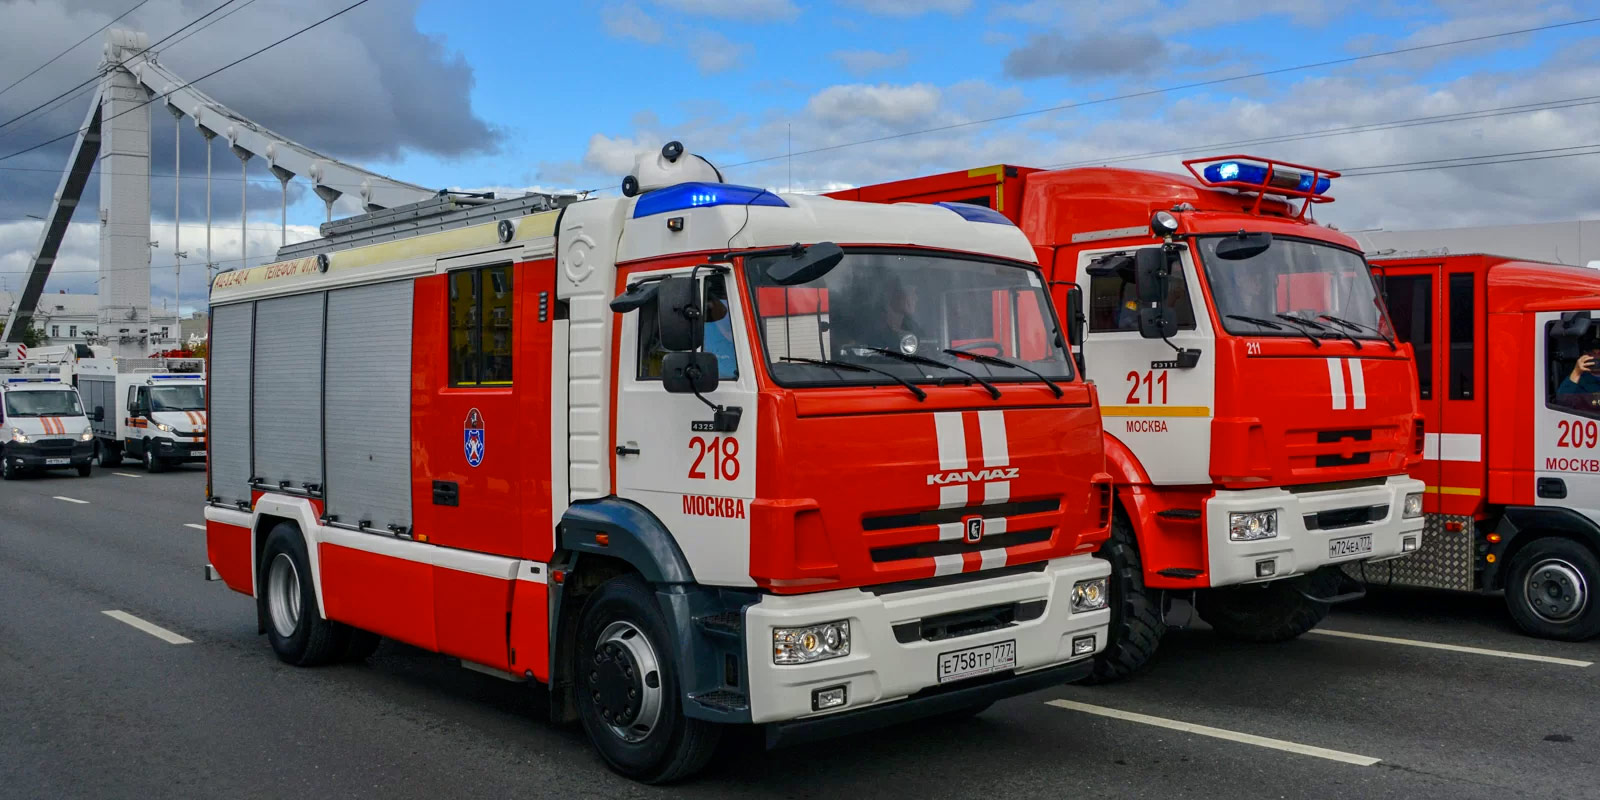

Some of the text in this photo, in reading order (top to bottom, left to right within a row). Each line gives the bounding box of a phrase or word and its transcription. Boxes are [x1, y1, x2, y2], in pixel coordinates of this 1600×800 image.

[264, 260, 300, 280] ТЕЛЕФОН
[1246, 342, 1262, 355] 211
[1125, 370, 1168, 405] 211
[1126, 420, 1168, 433] МОСКВА
[1556, 419, 1598, 449] 209
[687, 436, 740, 481] 218
[1545, 457, 1600, 472] МОСКВ
[926, 467, 1020, 486] KAMAZ
[682, 494, 746, 520] МОСКВА
[1360, 536, 1371, 548] 777
[943, 643, 1012, 674] Е758ТР 777
